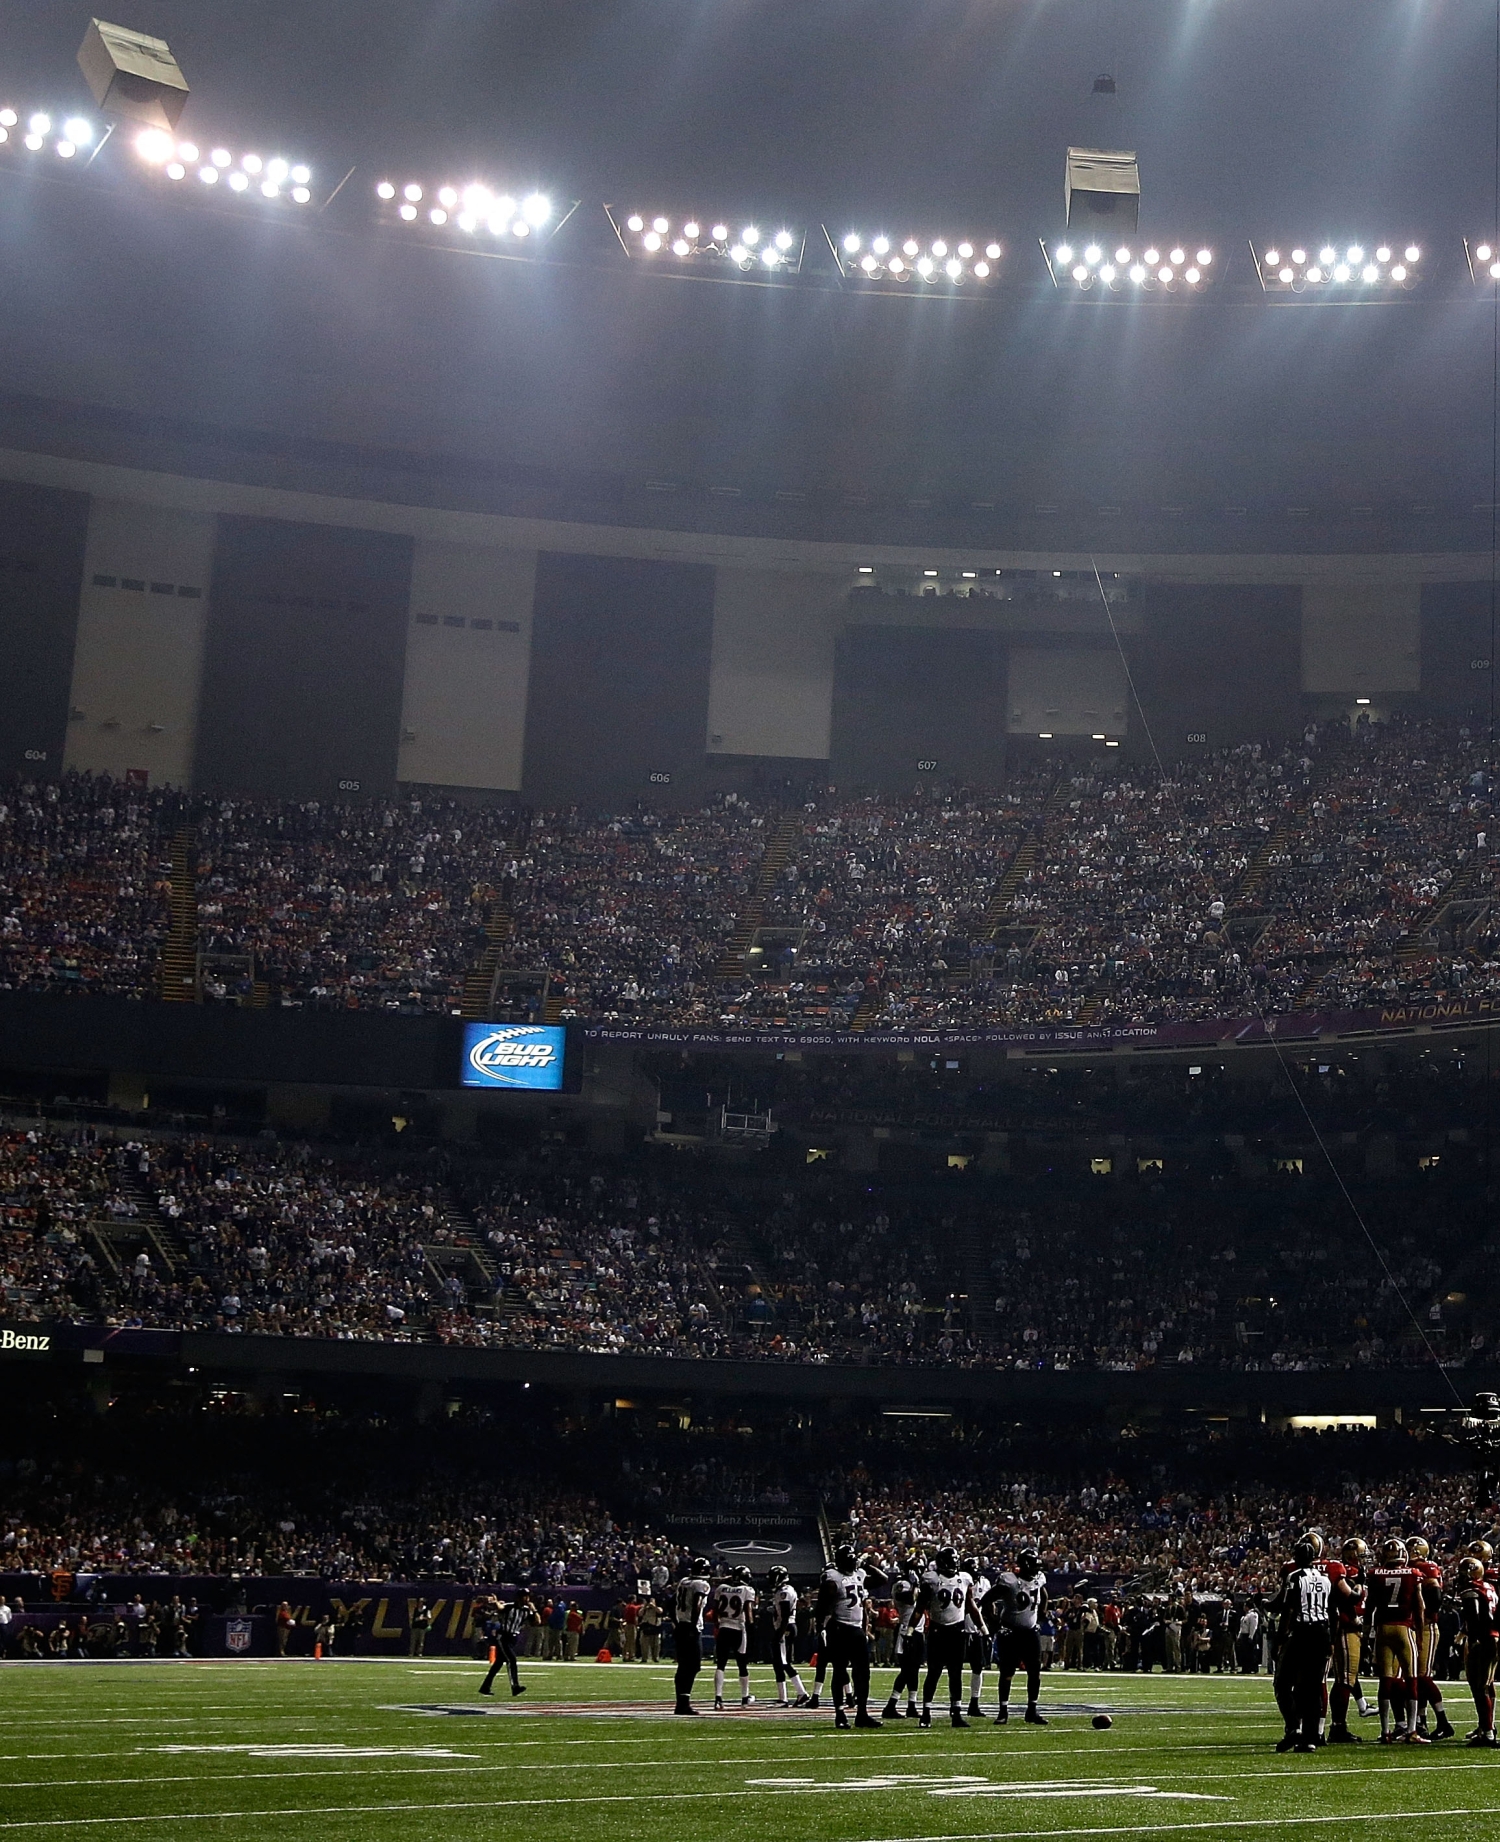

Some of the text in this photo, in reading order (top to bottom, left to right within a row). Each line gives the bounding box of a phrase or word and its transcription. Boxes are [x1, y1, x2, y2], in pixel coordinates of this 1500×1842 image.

[1470, 659, 1490, 669] 609
[1187, 733, 1206, 743] 608
[24, 749, 47, 761] 604
[917, 760, 937, 770] 607
[650, 772, 670, 783] 606
[338, 780, 360, 791] 605
[1381, 1003, 1473, 1022] NATIONAL
[584, 1029, 598, 1038] TO
[601, 1030, 643, 1040] REPORT
[647, 1033, 690, 1042] UNRULY
[693, 1034, 723, 1043] FANS:
[725, 1035, 752, 1044] SEND
[755, 1036, 780, 1044] TEXT
[783, 1036, 797, 1044] TO
[799, 1036, 834, 1045] 69050,
[837, 1036, 860, 1044] WITH
[863, 1036, 910, 1044] KEYWORD
[913, 1035, 941, 1043] NOLA
[985, 1033, 1036, 1042] FOLLOWED
[1039, 1032, 1052, 1041] BY
[1055, 1031, 1084, 1040] ISSUE
[494, 1042, 553, 1056] BUD
[480, 1052, 557, 1067] LIGHT
[744, 1515, 801, 1526] Superdome
[1309, 1582, 1322, 1593] 76
[1385, 1577, 1402, 1607] 7
[938, 1588, 964, 1609] 90
[719, 1595, 743, 1618] 29
